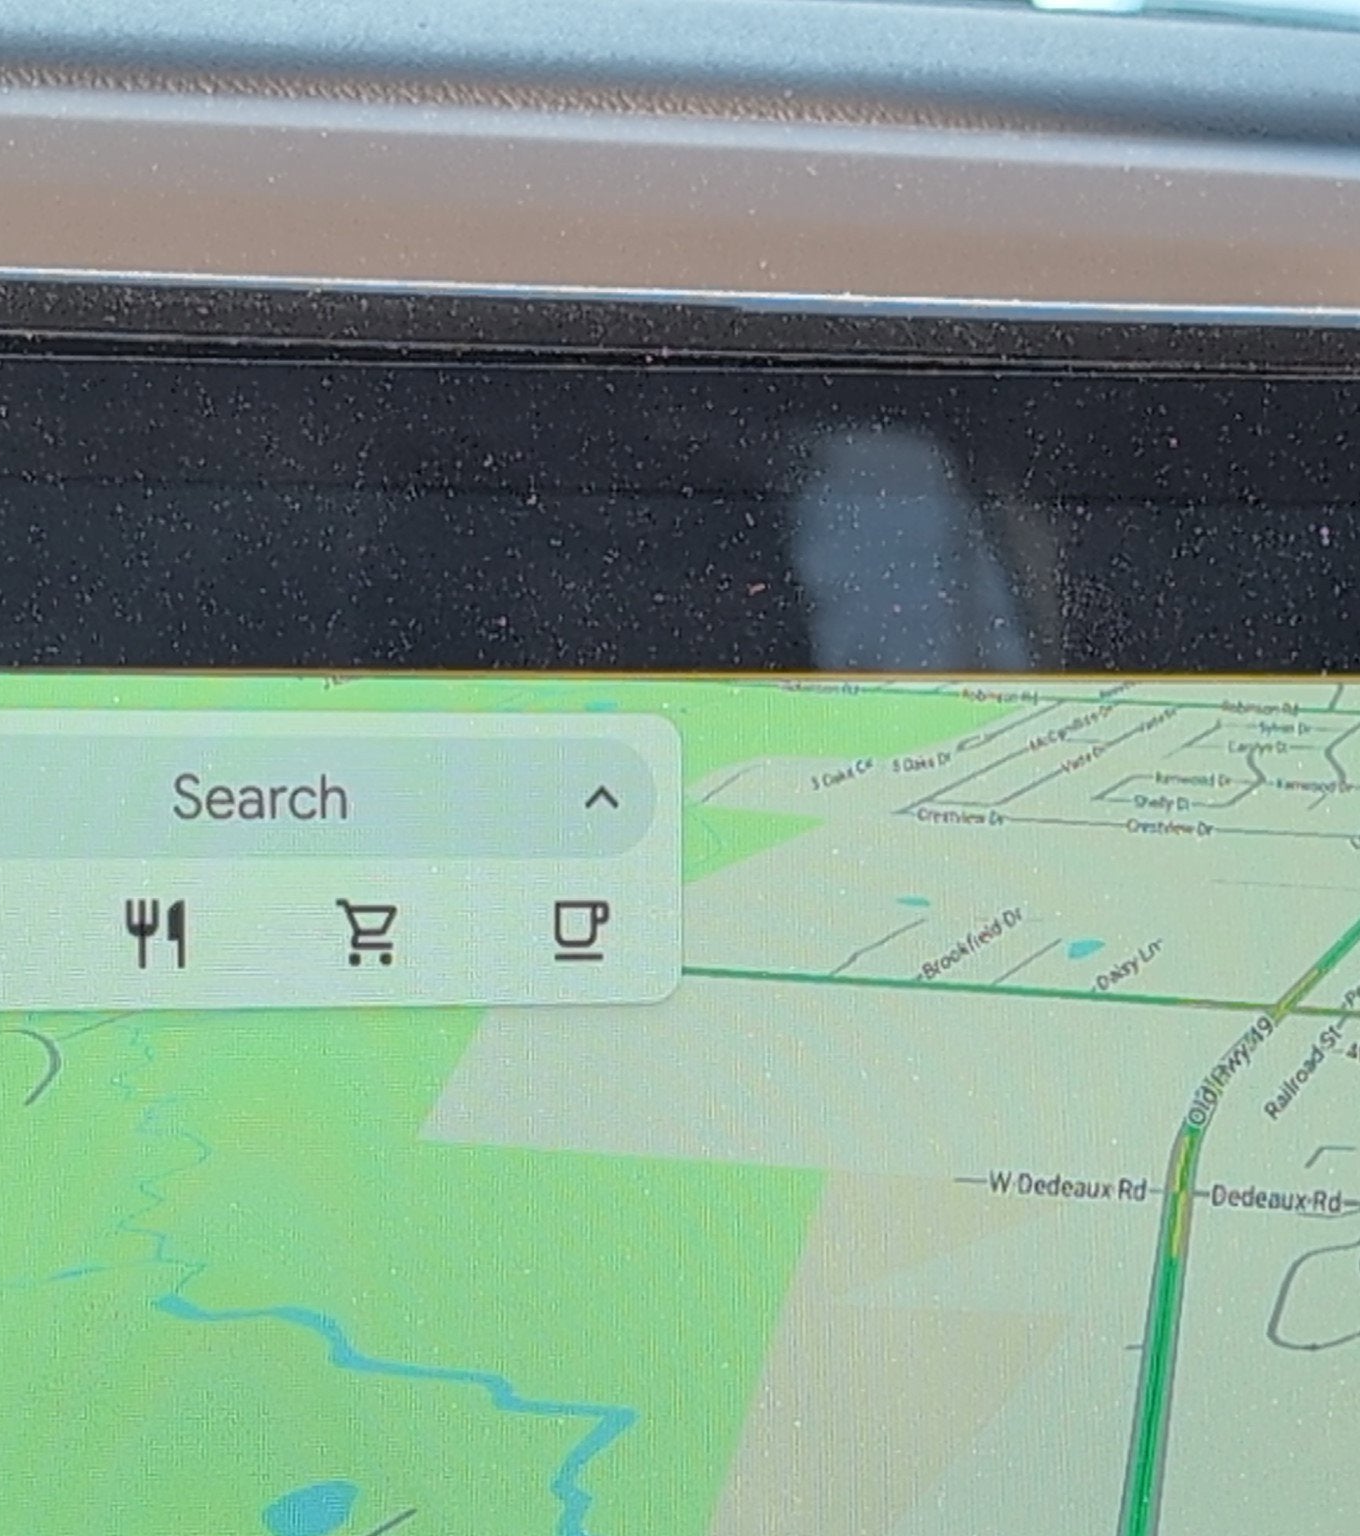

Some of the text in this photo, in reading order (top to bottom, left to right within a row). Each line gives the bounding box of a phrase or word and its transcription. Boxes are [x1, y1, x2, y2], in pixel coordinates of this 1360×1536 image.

[172, 771, 349, 824] Search
[921, 906, 1024, 981] Brookfield Dr
[1095, 955, 1140, 991] Daisy
[1263, 1024, 1344, 1122] Railroad St
[989, 1170, 1147, 1201] W Dedeaux Rd
[1211, 1183, 1342, 1213] Dedeaux Rd
